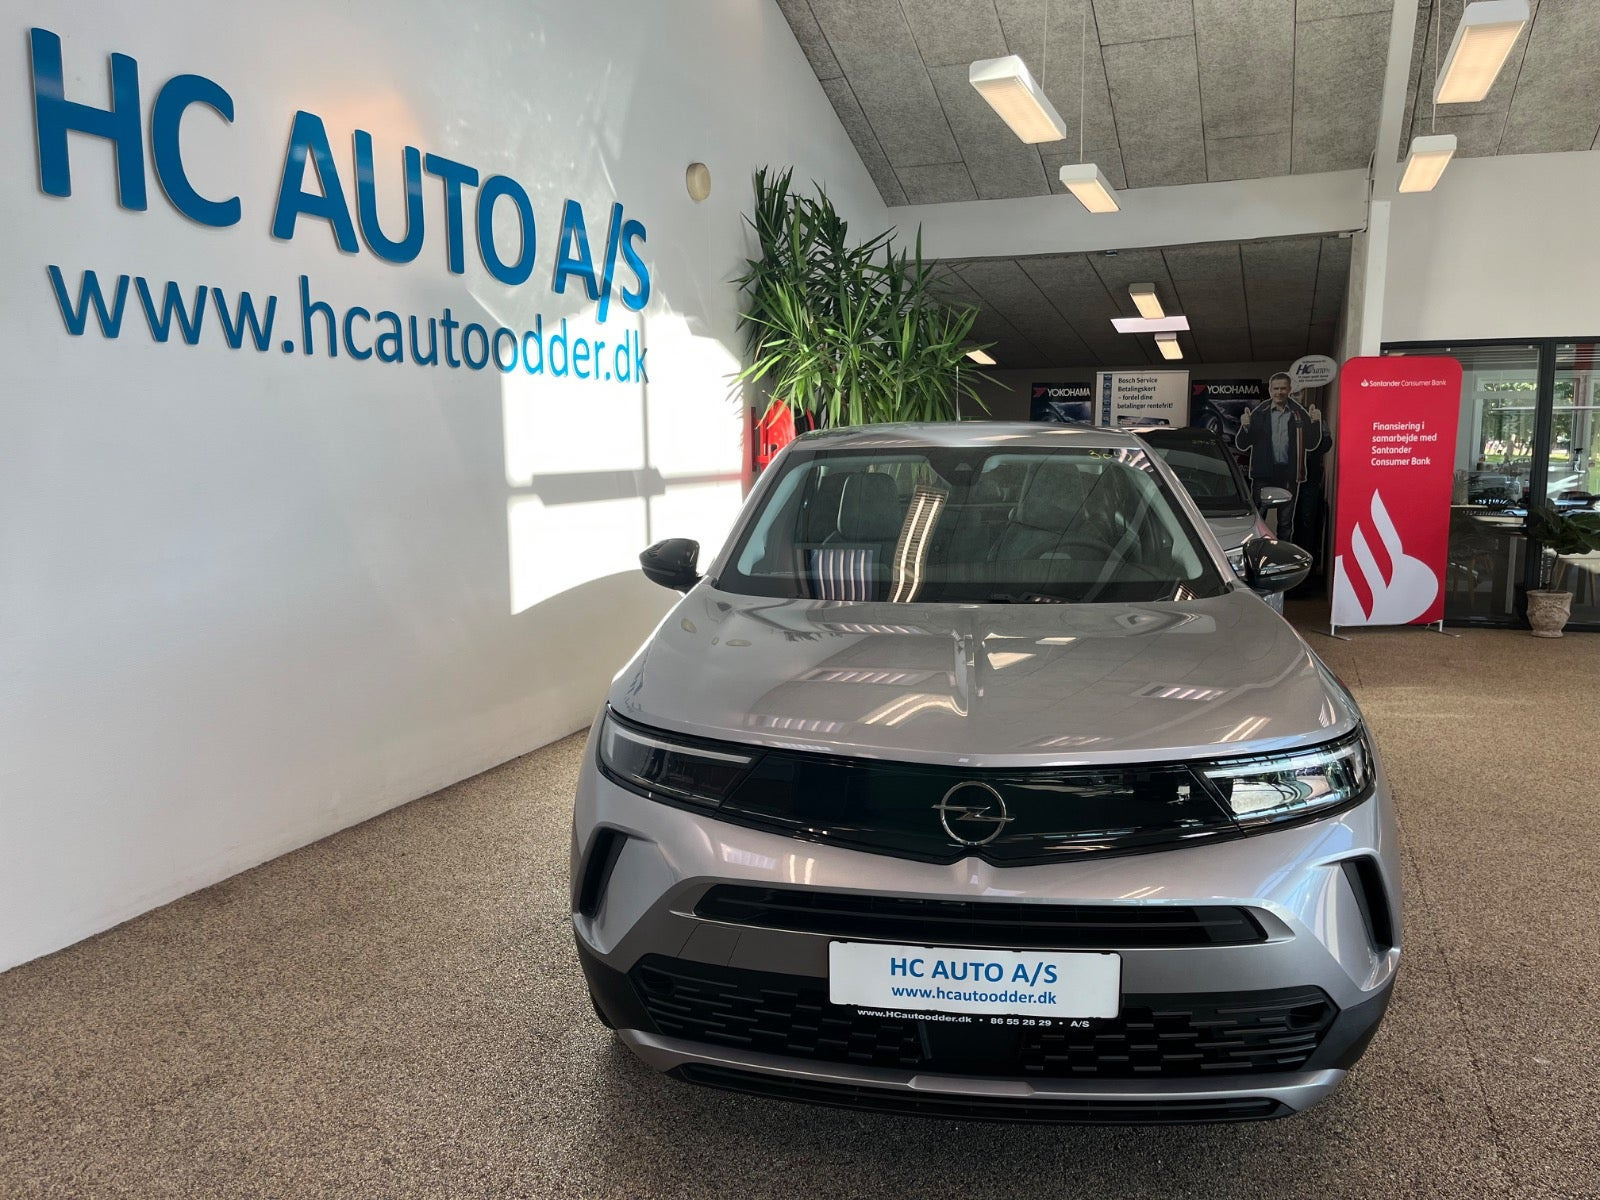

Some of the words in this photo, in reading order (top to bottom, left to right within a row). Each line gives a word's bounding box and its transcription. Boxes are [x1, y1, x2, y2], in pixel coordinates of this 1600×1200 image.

[29, 27, 241, 228] HC
[272, 110, 536, 286] AUTO
[553, 199, 651, 323] A/S
[48, 264, 649, 384] www.hcautoodder.dk
[1401, 379, 1431, 387] Consumer
[1047, 387, 1091, 397] YOKOHAMA
[1207, 384, 1260, 394] YOKOHAMA
[1117, 402, 1146, 410] betalinger
[1372, 422, 1420, 432] Finansiering
[1372, 433, 1418, 444] samarbejde
[1420, 433, 1437, 441] med
[1371, 445, 1412, 454] Santander
[1371, 457, 1409, 466] Consumer
[1411, 457, 1431, 465] Bank
[890, 957, 925, 978] HC
[931, 959, 1004, 983] AUTO
[1011, 962, 1058, 987] A/S
[891, 986, 1057, 1005] www.hcautoodder.dk
[857, 1009, 973, 1024] www.HCautoodder.dk
[990, 1017, 1004, 1026] 86
[1006, 1017, 1020, 1026] 55
[1022, 1018, 1036, 1027] 28
[1038, 1018, 1052, 1027] 29
[1070, 1019, 1090, 1028] A/S
